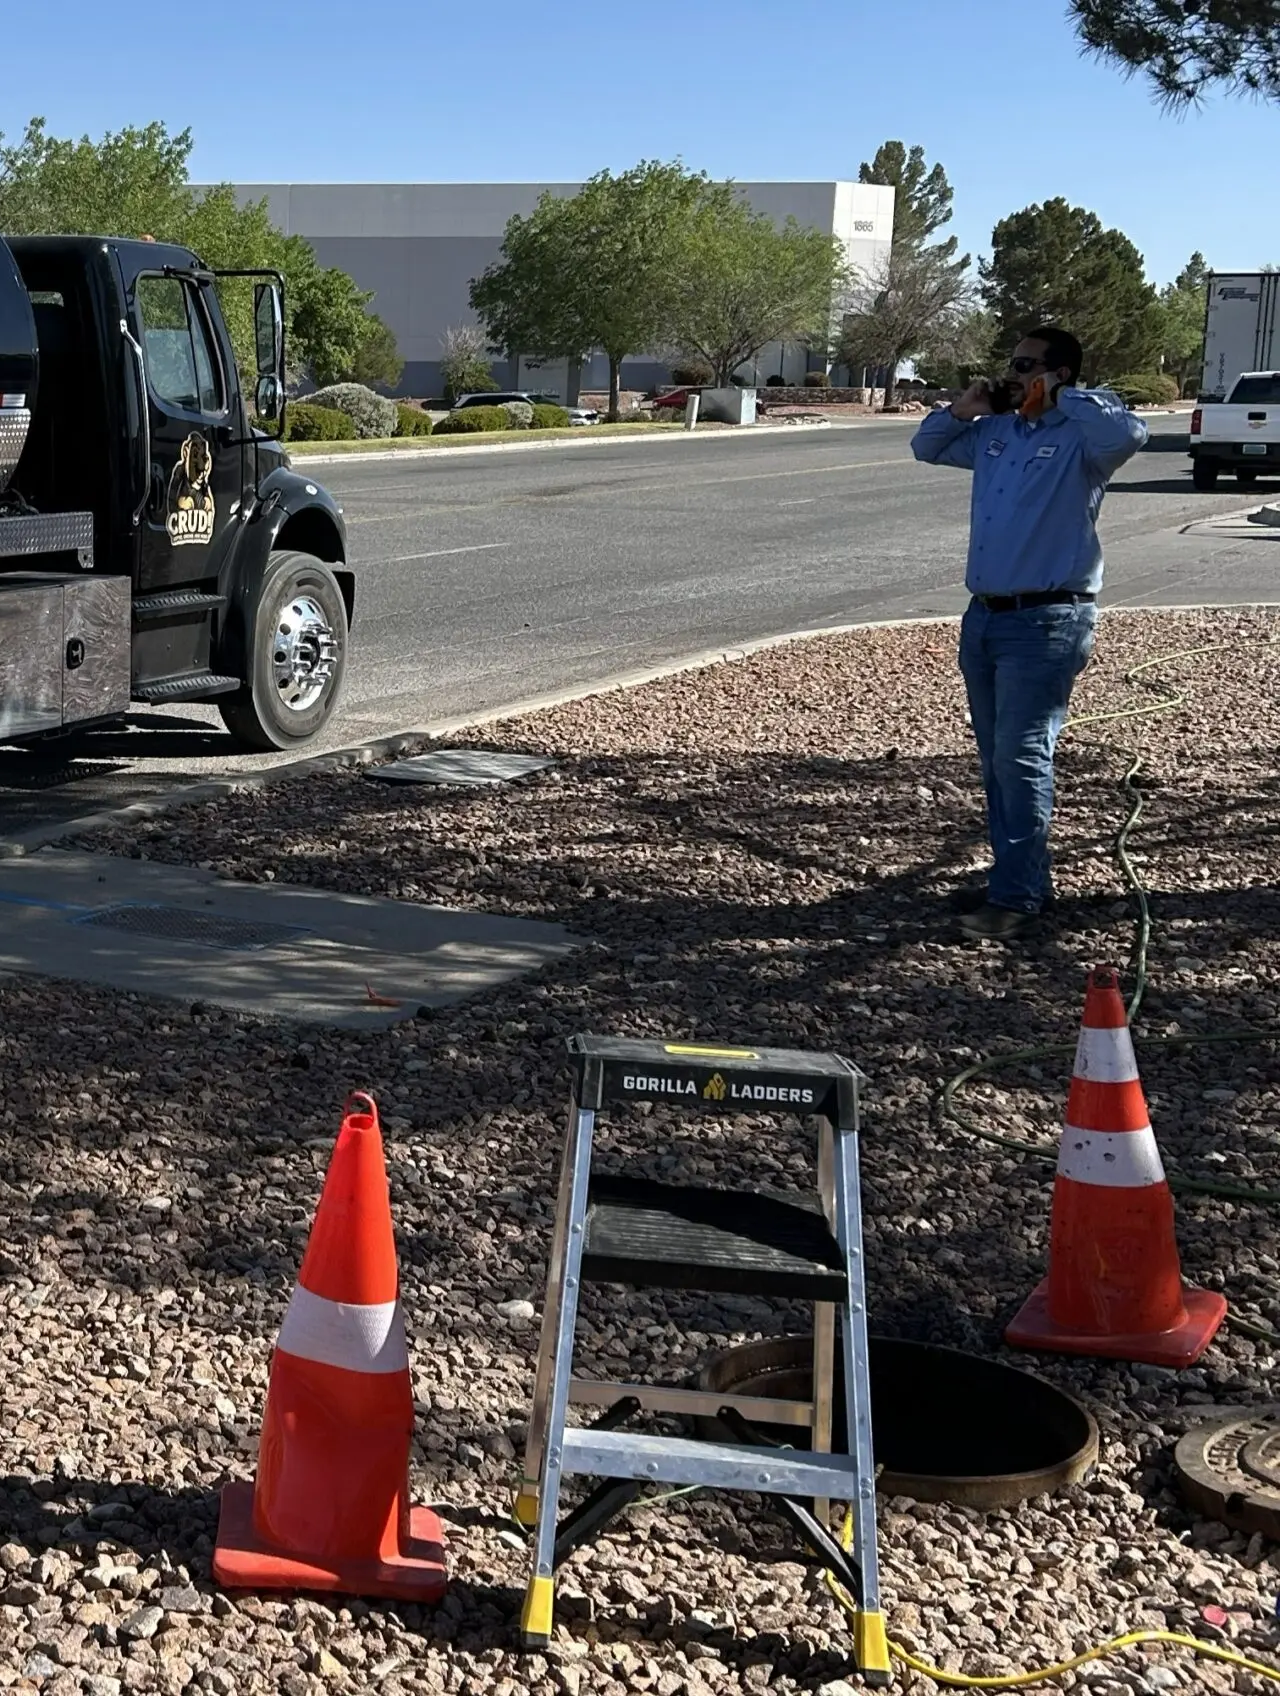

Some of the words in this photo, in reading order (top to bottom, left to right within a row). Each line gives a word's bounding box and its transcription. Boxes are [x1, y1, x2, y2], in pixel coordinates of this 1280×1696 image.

[168, 509, 212, 536] CRUD!
[623, 1075, 697, 1095] GORILLA
[730, 1083, 813, 1103] LADDERS
